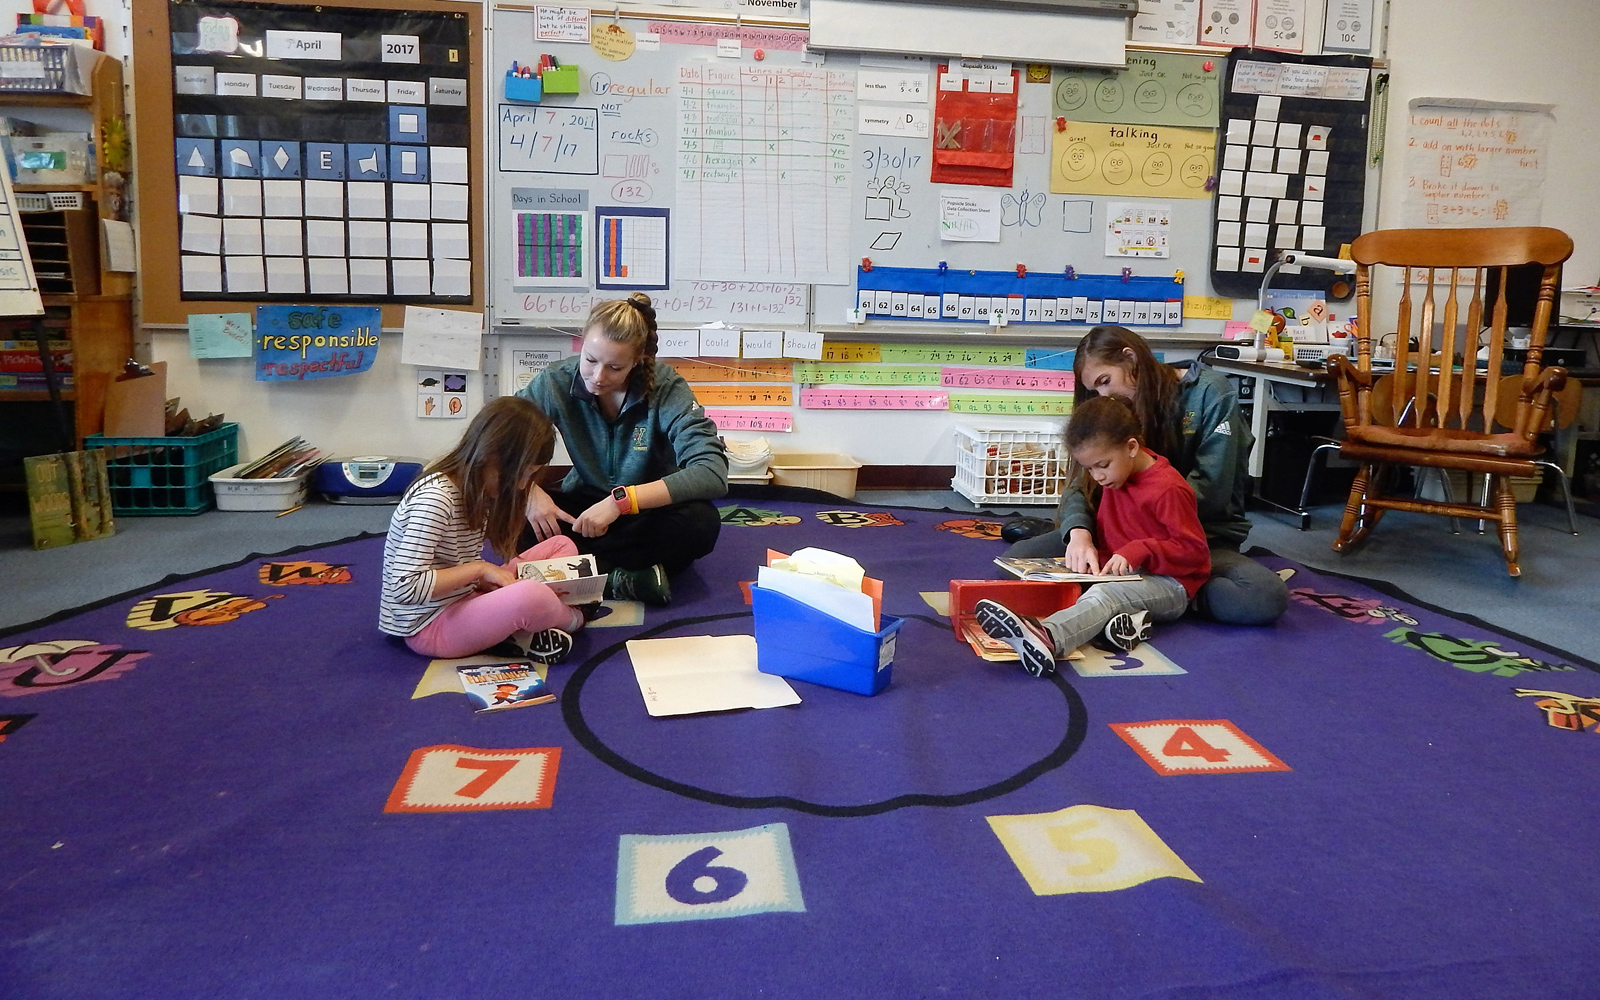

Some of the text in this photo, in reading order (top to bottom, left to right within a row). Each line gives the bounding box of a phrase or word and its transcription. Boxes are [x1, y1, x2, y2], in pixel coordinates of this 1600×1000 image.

[296, 40, 322, 51] April
[386, 44, 415, 55] 2017
[680, 67, 700, 78] Date
[708, 69, 736, 82] Figure
[1201, 73, 1217, 83] good
[268, 82, 296, 91] Tuesday
[306, 85, 342, 93] Wednesday
[351, 86, 381, 94] Thursday
[397, 88, 416, 96] Friday
[435, 87, 462, 96] Saturday
[596, 76, 671, 103] irregular
[707, 88, 847, 102] square yes
[601, 103, 623, 112] NOT
[833, 107, 847, 115] yes
[503, 108, 537, 128] April
[864, 117, 890, 125] symmetry
[1446, 118, 1459, 127] all
[1462, 118, 1477, 128] the
[611, 129, 652, 143] rocks
[705, 126, 846, 141] rhombus yes
[1109, 126, 1159, 144] talking
[830, 148, 846, 156] yes
[1146, 142, 1161, 150] Just
[1202, 144, 1216, 152] good
[1422, 140, 1438, 150] add
[1441, 143, 1452, 151] on
[1505, 144, 1538, 155] number
[705, 153, 845, 170] hexagon no
[702, 168, 846, 184] rectangle yes
[618, 186, 644, 198] 132
[513, 193, 581, 204] Days in School
[894, 303, 904, 311] 63
[1010, 308, 1020, 316] 70
[1168, 311, 1178, 319] 80
[287, 307, 342, 330] safe
[261, 326, 379, 359] responsible
[665, 338, 818, 350] over could would should
[525, 352, 549, 360] Private
[826, 351, 834, 359] 17
[988, 354, 1012, 363] 28 29
[265, 352, 363, 381] respectful
[944, 376, 954, 385] 61
[958, 376, 969, 385] 62
[1015, 378, 1027, 386] 66
[1030, 379, 1039, 387] 67
[1057, 380, 1066, 388] 69
[968, 404, 979, 412] 92
[983, 404, 992, 412] 93
[749, 420, 763, 429] 108
[720, 504, 763, 522] A
[825, 511, 869, 526] B
[487, 669, 530, 682] STANLEY
[1160, 726, 1232, 764] 4
[452, 756, 521, 800] 7
[1063, 820, 1122, 878] 5
[664, 845, 749, 907] 6
